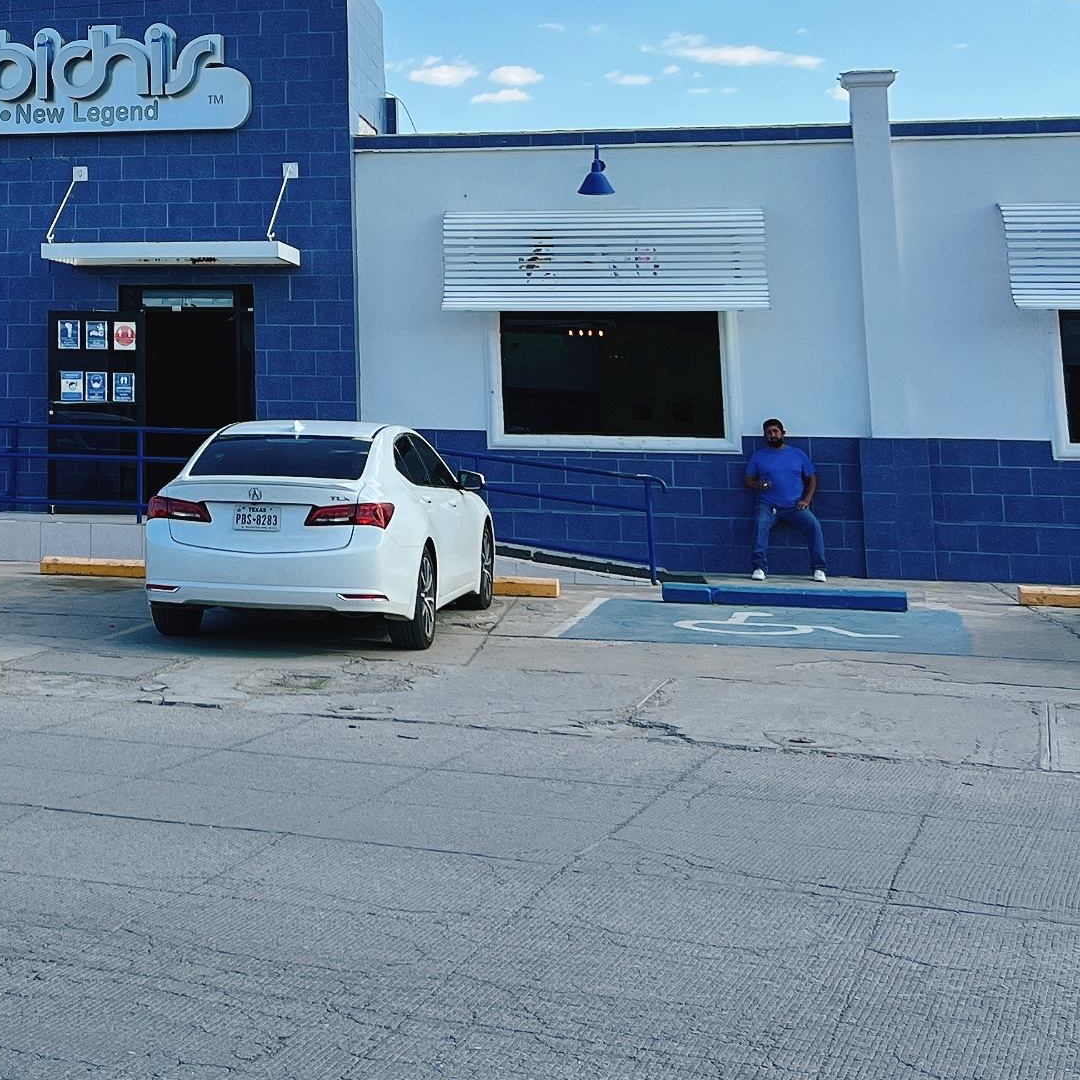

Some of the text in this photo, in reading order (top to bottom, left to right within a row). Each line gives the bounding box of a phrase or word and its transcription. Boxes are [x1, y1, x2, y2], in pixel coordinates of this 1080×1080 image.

[207, 94, 224, 105] TM
[15, 103, 66, 125] New
[72, 99, 159, 127] Legend
